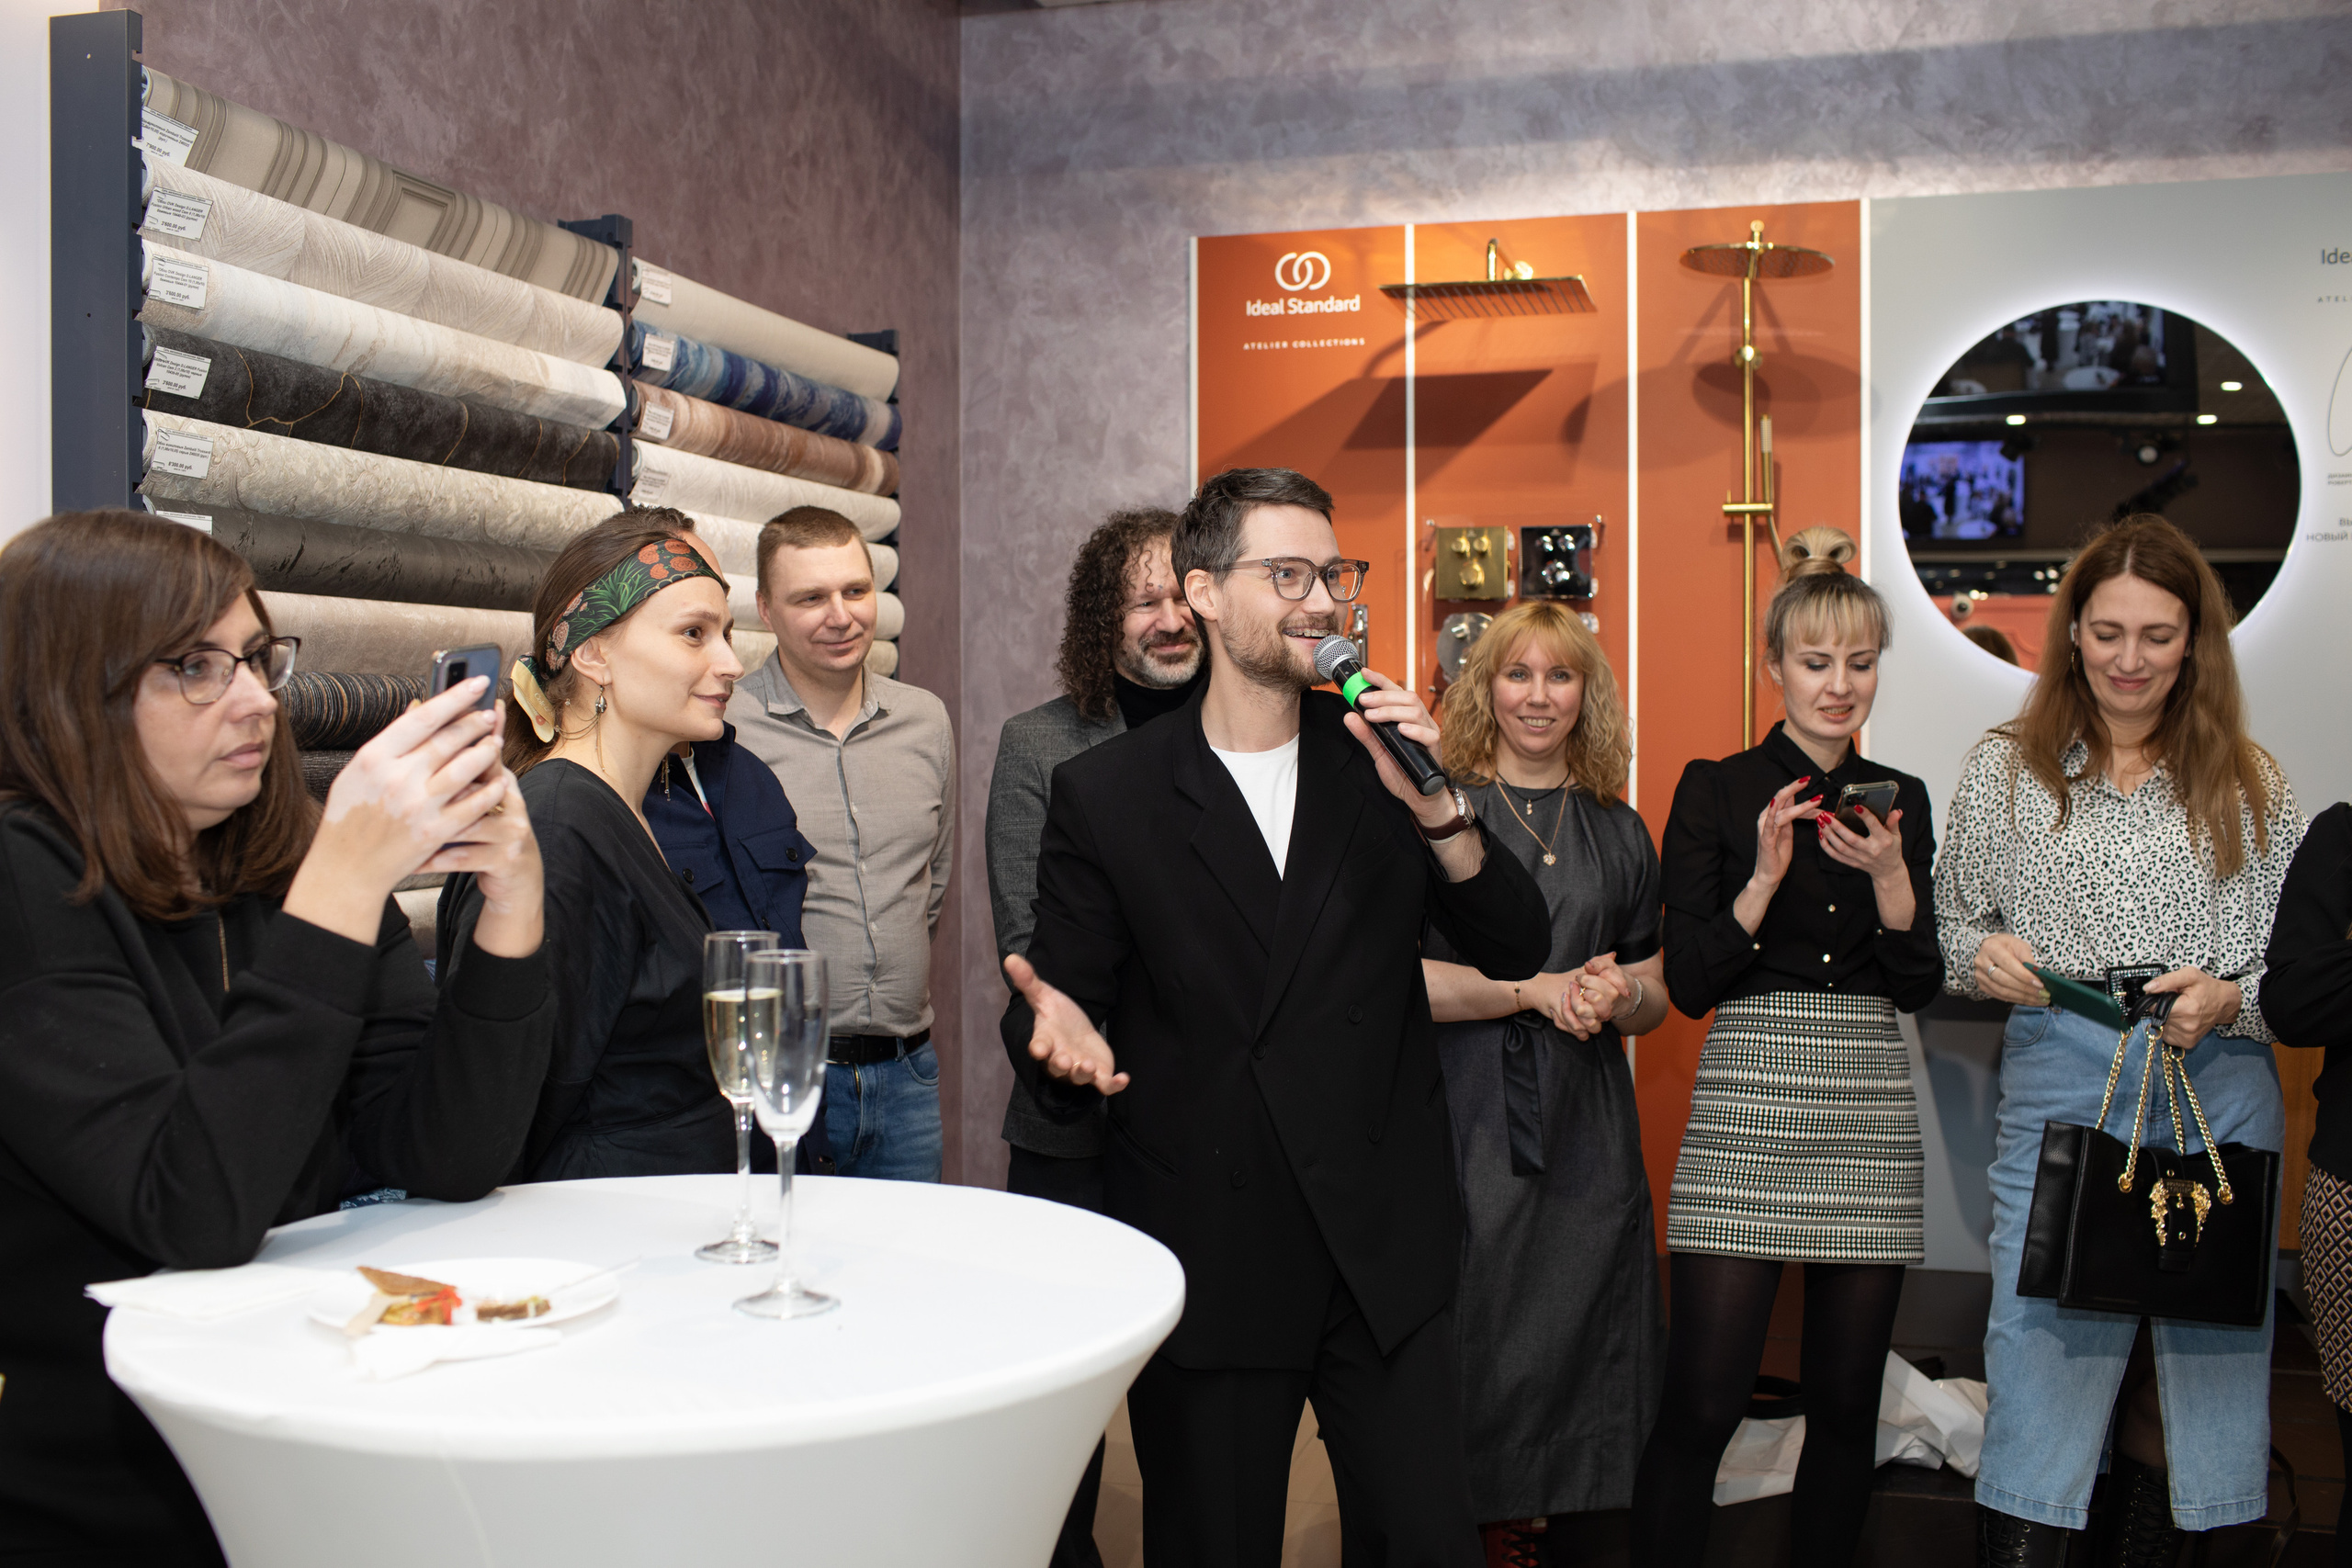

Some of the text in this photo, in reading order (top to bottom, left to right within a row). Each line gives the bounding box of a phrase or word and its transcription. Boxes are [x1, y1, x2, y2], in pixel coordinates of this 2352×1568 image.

[2321, 247, 2352, 265] Ide
[1246, 294, 1361, 316] Ideal Standard
[1243, 337, 1365, 350] ATELIER COLLECTIONS
[2306, 530, 2348, 542] НОВЫЙ
